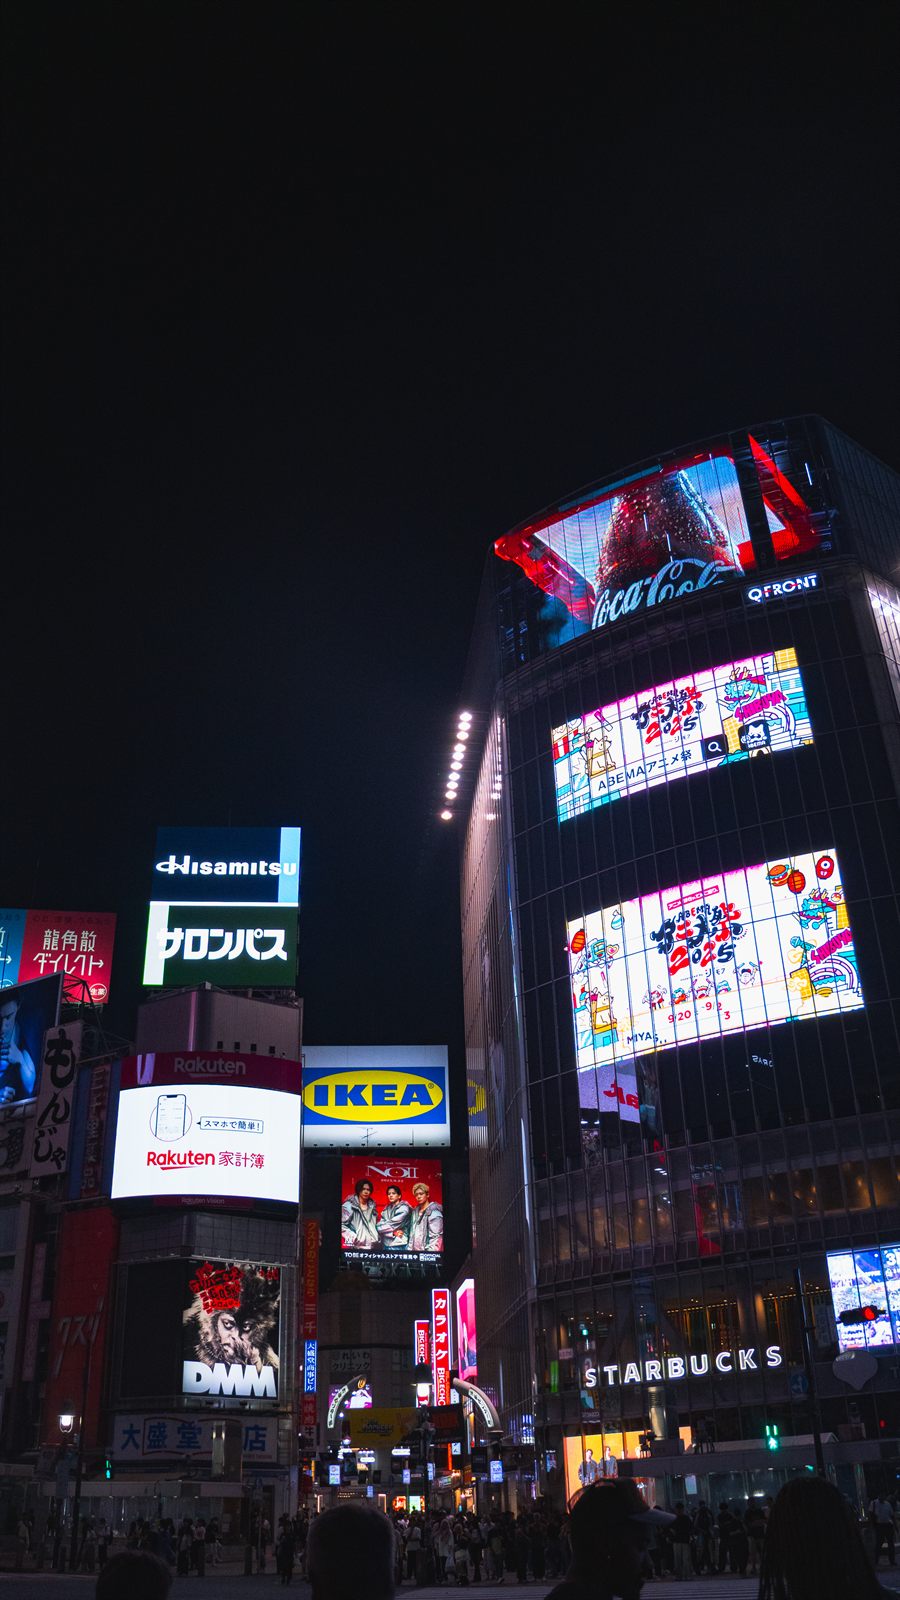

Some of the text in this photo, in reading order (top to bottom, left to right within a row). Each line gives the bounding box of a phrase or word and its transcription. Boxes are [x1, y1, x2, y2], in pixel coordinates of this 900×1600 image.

[645, 715, 699, 745] 2025
[155, 854, 298, 876] Hisamitsu
[42, 928, 97, 952] 龍角散
[156, 927, 288, 961] サロンパス
[33, 952, 104, 977] ダイレクト
[670, 940, 737, 976] 2025
[174, 1057, 247, 1076] Rakuten
[33, 1028, 76, 1170] もんじゃ
[313, 1083, 435, 1107] IKEA
[147, 1150, 265, 1169] Rakuten 家計簿
[417, 1329, 425, 1344] BIG
[435, 1297, 449, 1361] カラオケ
[182, 1360, 278, 1398] DMM
[437, 1367, 446, 1384] BIG
[585, 1345, 783, 1388] STARBUCKS
[120, 1420, 268, 1452] 大盛堂店
